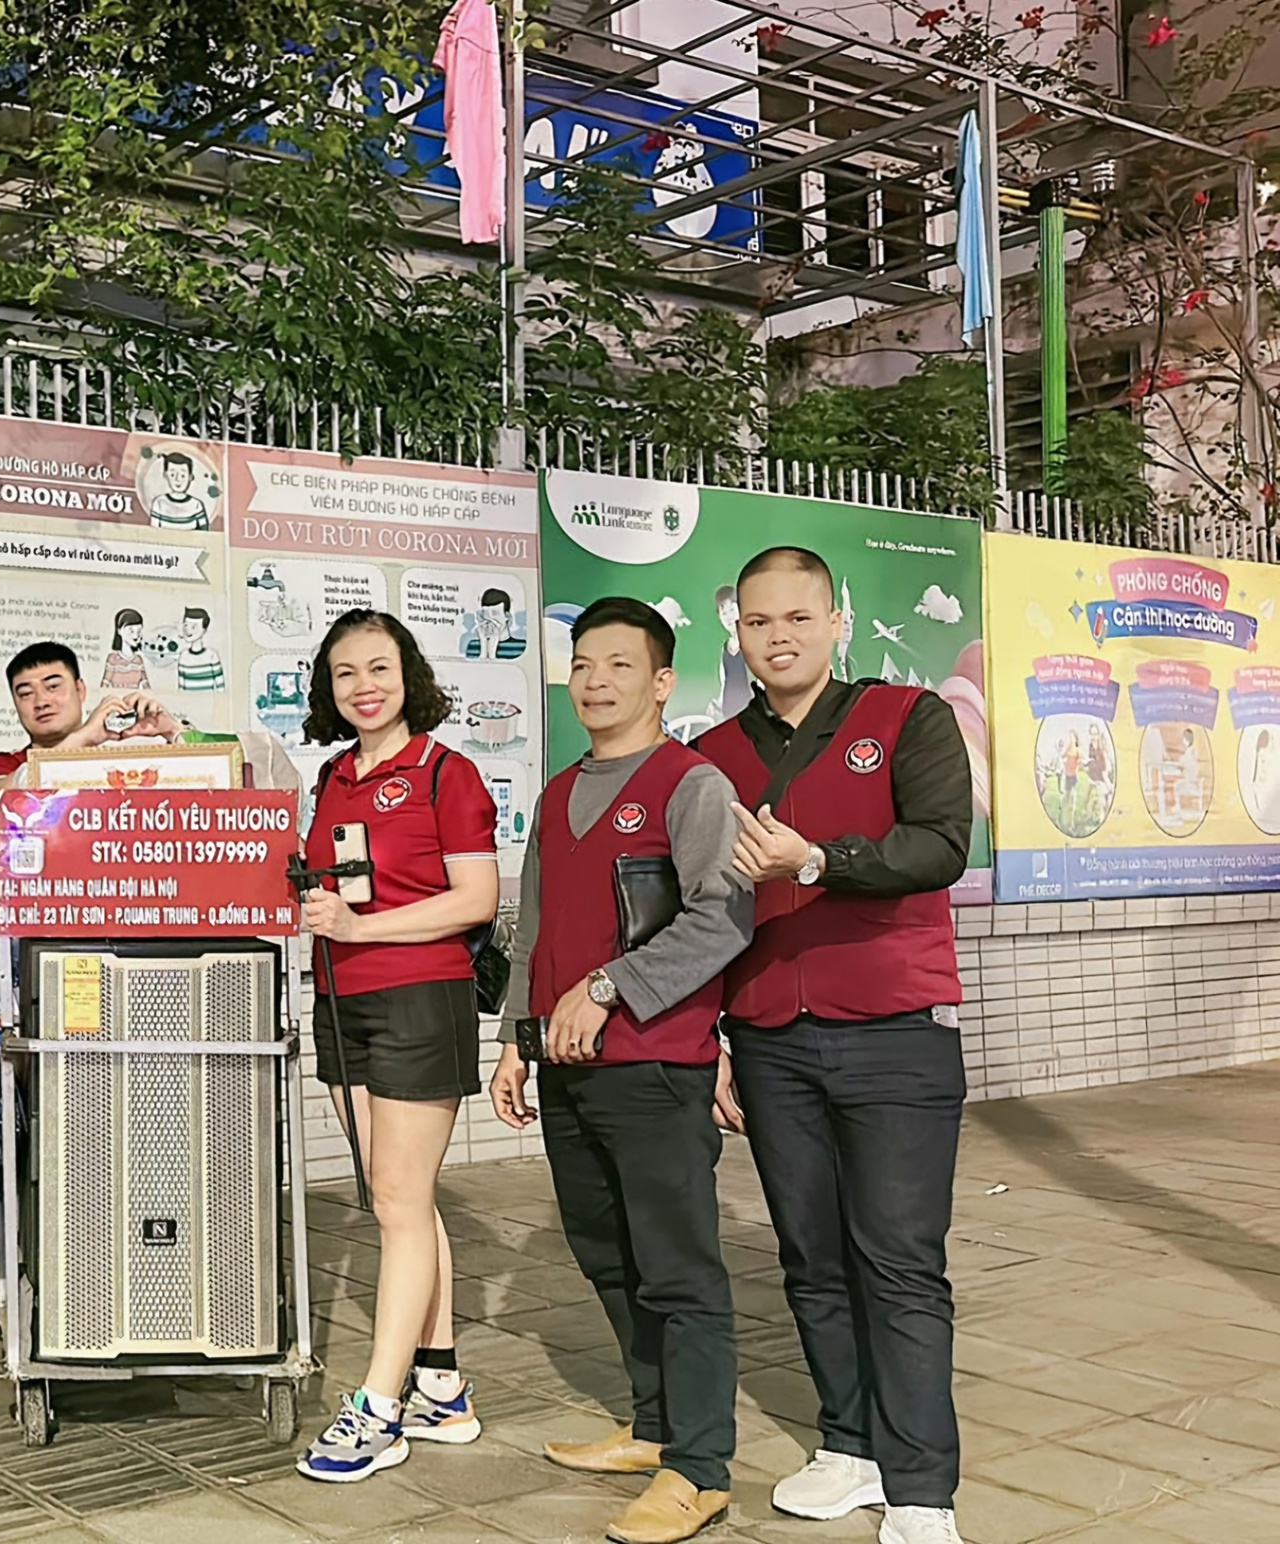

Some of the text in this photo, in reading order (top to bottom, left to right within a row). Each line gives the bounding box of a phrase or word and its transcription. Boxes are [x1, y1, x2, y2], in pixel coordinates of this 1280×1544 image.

[271, 472, 299, 487] CÁC
[87, 491, 133, 514] MỚI
[242, 517, 528, 559] DO VI RÚT CORONA MỚI
[53, 547, 66, 558] do
[97, 550, 131, 563] Corona
[1117, 567, 1222, 602] PHÒNG CHỐNG
[1113, 605, 1142, 631] Cận
[1165, 608, 1191, 632] học
[1193, 612, 1234, 640] đường
[69, 799, 289, 831] CLB KẾT NỐI YÊU THƯƠNG
[92, 840, 268, 863] STK: 0580113979999
[21, 876, 51, 897] NGÂN
[54, 876, 84, 897] HÀNG
[87, 876, 116, 899] QUÂN
[158, 876, 178, 900] NỘI
[43, 907, 57, 924] 23
[59, 903, 80, 925] TÂY
[115, 907, 160, 926] P.QUANG
[163, 907, 198, 924] TRUNG
[276, 907, 292, 924] HN
